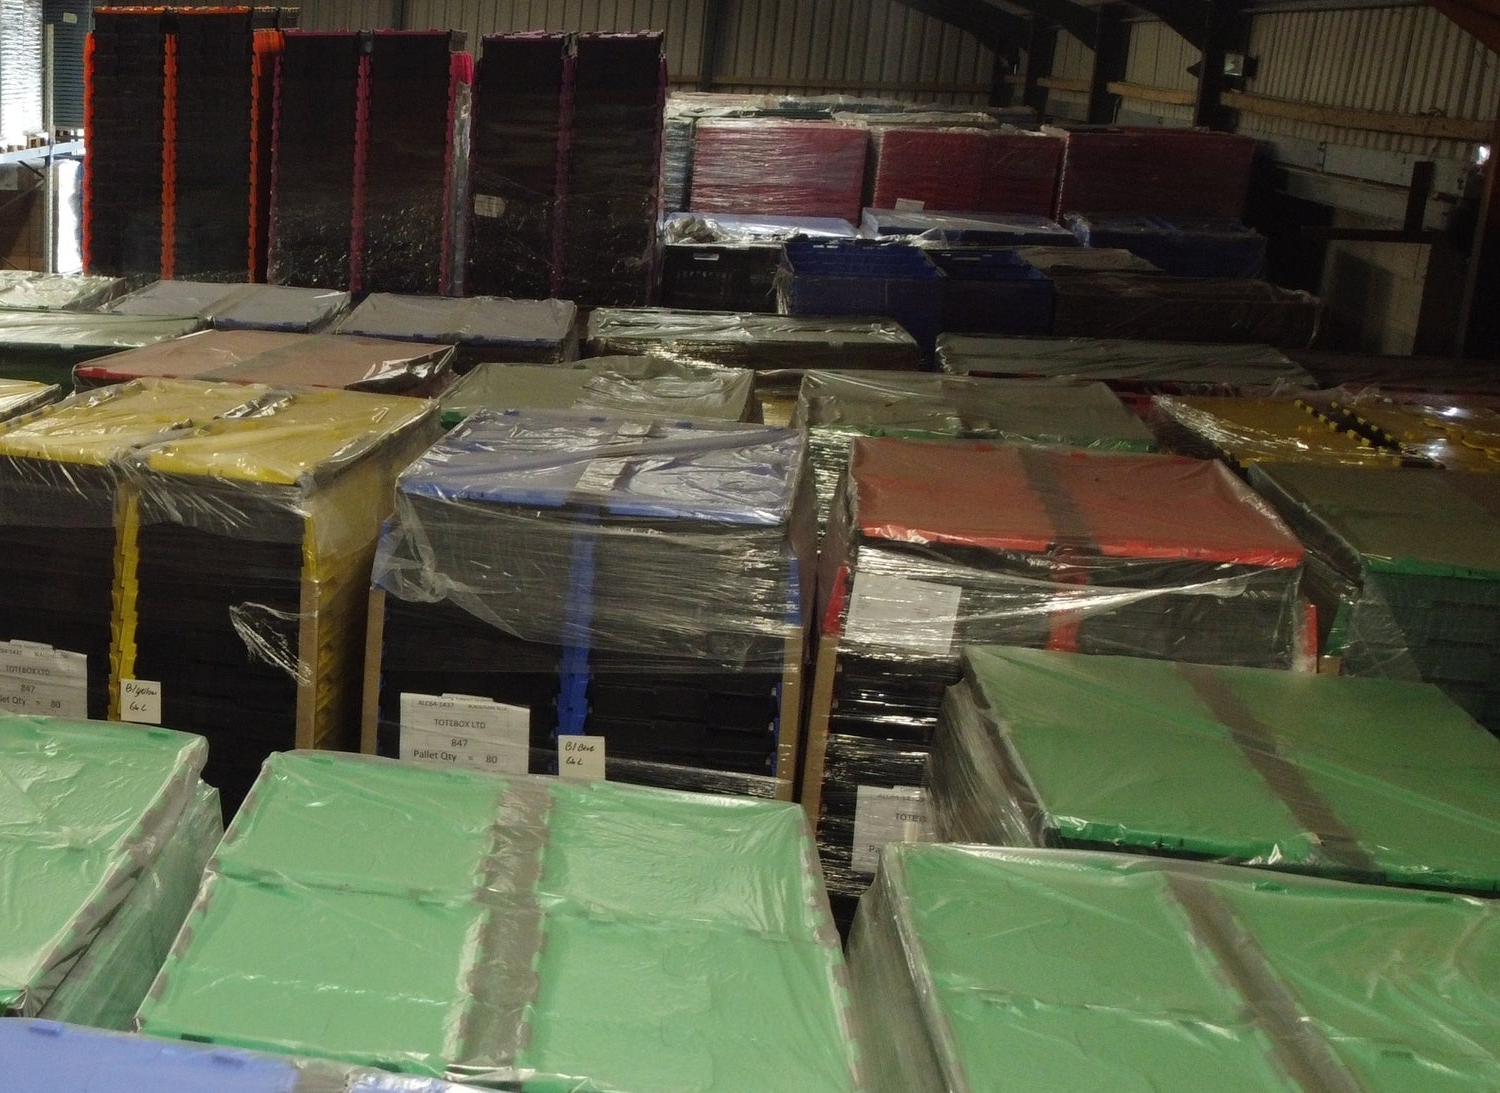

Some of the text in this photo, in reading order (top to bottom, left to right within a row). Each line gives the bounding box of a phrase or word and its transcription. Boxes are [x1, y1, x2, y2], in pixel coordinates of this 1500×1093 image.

[20, 684, 35, 692] 847
[12, 696, 26, 706] Qty
[50, 700, 61, 709] 80
[434, 719, 486, 729] TOTEBOX LTD
[451, 738, 468, 747] 847
[413, 749, 438, 760] Pallet
[440, 751, 457, 763] Qty
[485, 755, 498, 764] 80
